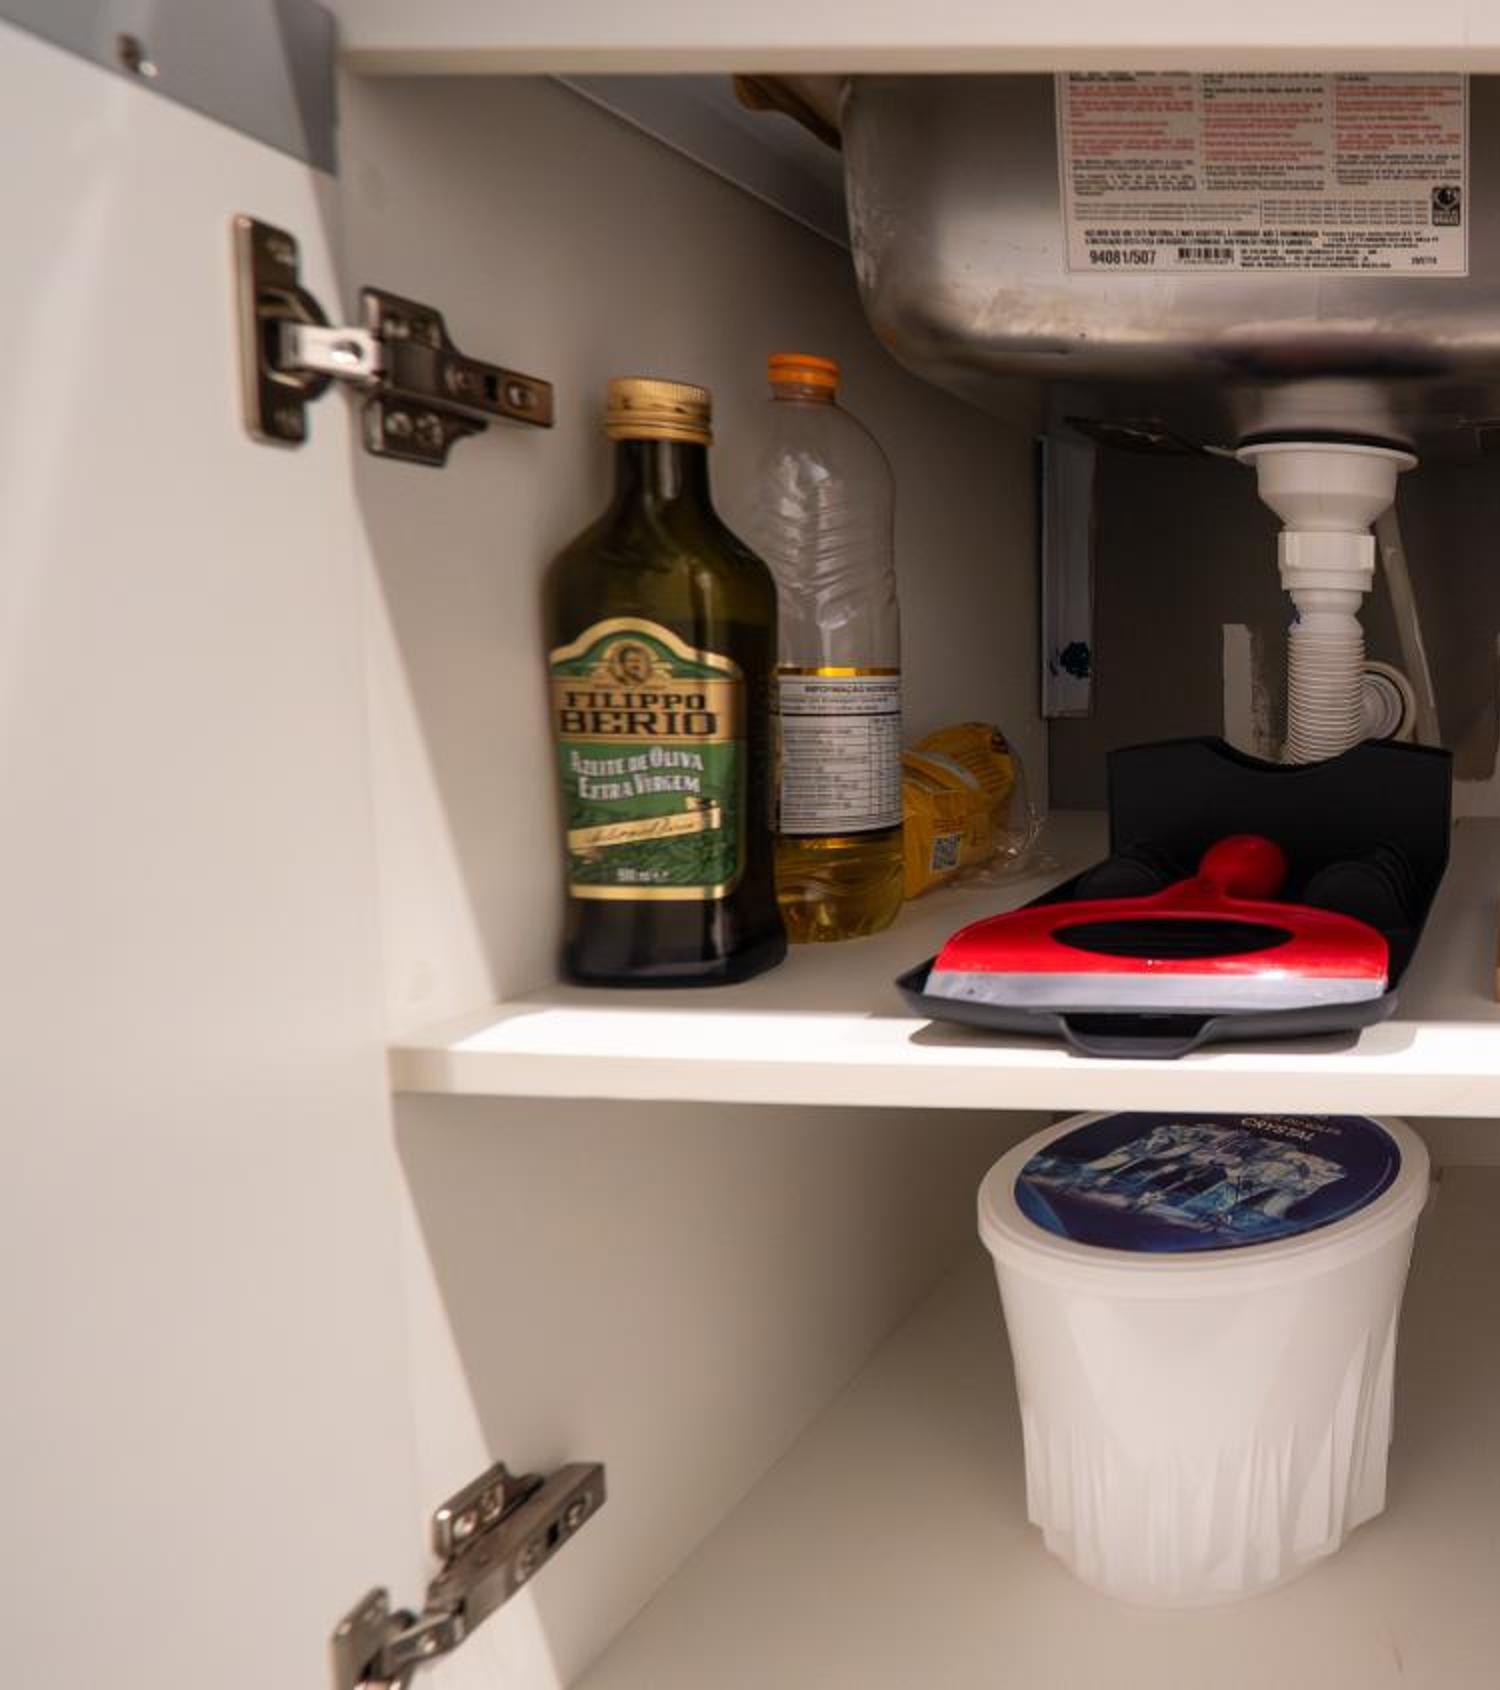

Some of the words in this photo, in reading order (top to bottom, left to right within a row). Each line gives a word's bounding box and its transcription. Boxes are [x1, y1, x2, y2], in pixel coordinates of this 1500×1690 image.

[1089, 249, 1156, 265] 94081/507
[564, 690, 707, 711] FILIPPO
[559, 709, 718, 736] BERIO
[1240, 1116, 1316, 1141] CRYSTAL
